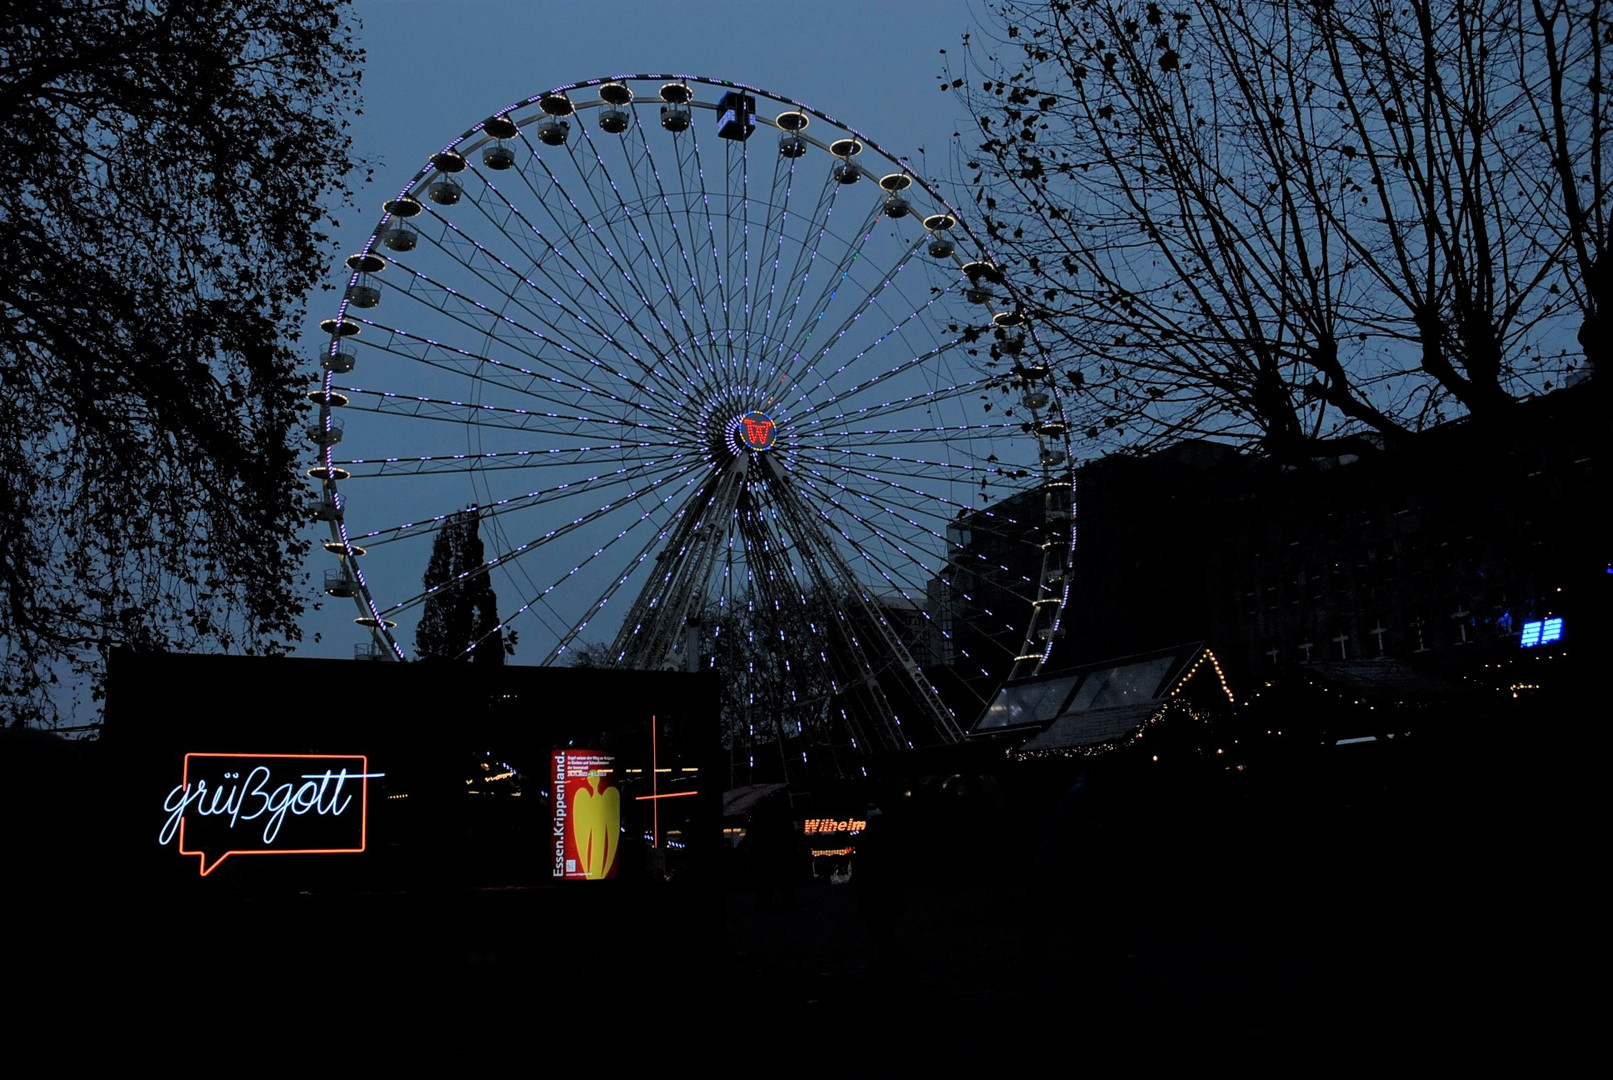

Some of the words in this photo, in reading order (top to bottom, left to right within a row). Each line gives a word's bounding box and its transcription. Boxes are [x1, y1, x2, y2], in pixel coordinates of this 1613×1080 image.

[744, 419, 772, 445] W
[159, 766, 386, 846] grüßgott
[552, 751, 567, 877] Essen.Krippenland.
[803, 818, 866, 832] Wilhelm
